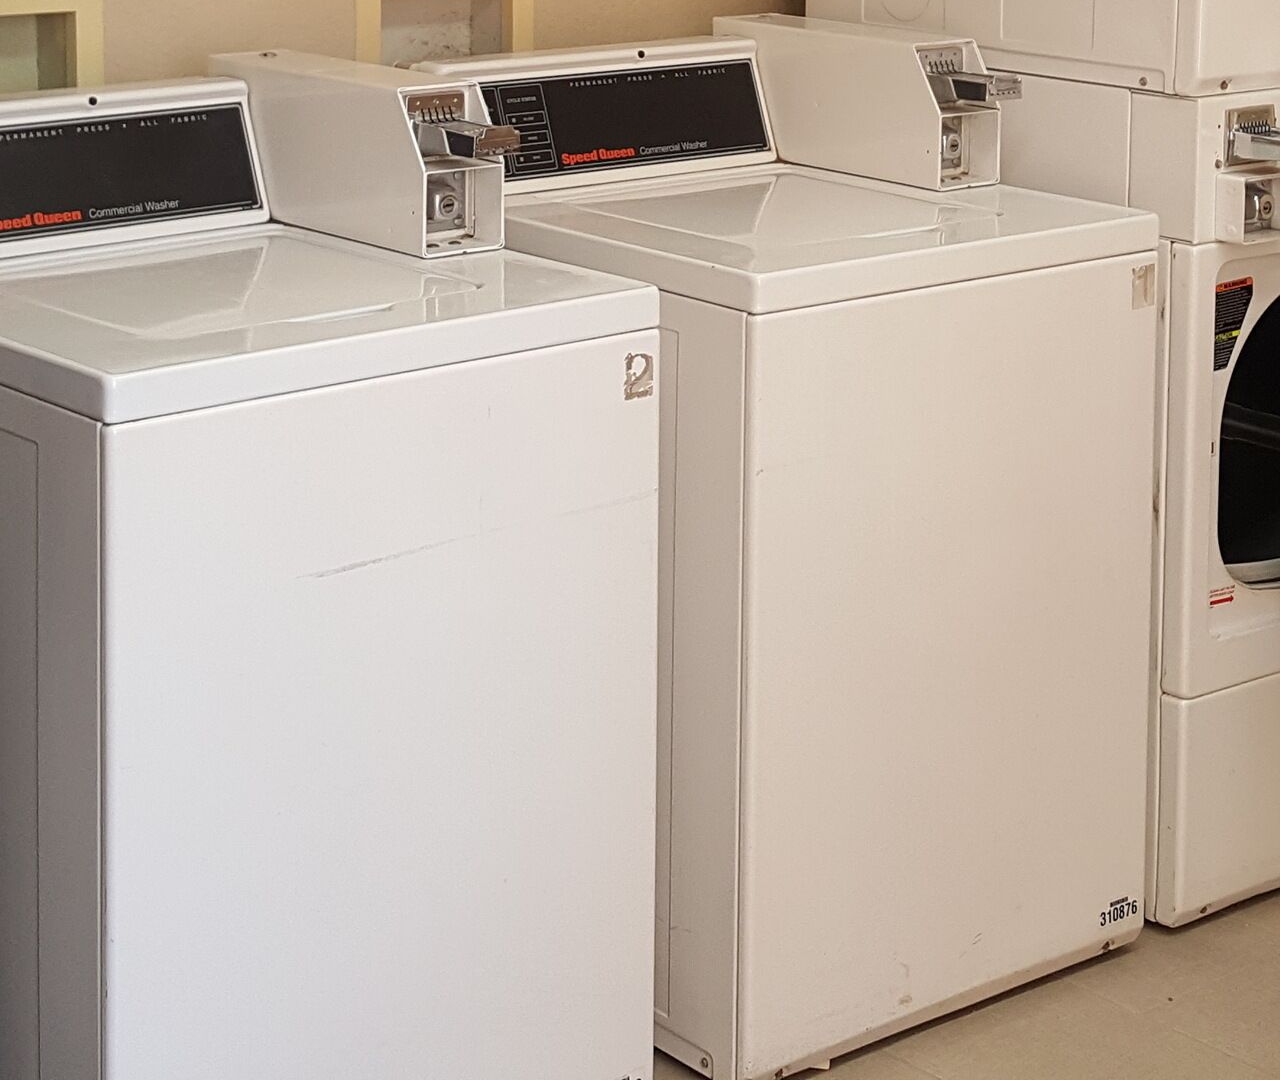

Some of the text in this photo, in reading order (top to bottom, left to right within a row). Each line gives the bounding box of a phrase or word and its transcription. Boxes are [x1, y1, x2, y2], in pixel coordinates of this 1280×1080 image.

[570, 77, 618, 88] PERMANENT
[627, 74, 653, 82] PRESS
[697, 67, 727, 76] FABRIC
[76, 124, 110, 133] PRESS
[140, 119, 159, 127] ALL
[171, 114, 208, 124] FABRIC
[561, 140, 708, 165] Speed Queen Commercial Washer
[33, 209, 83, 226] Queen
[88, 203, 143, 220] Commercial
[144, 199, 180, 213] Washer
[1100, 899, 1138, 927] 310876
